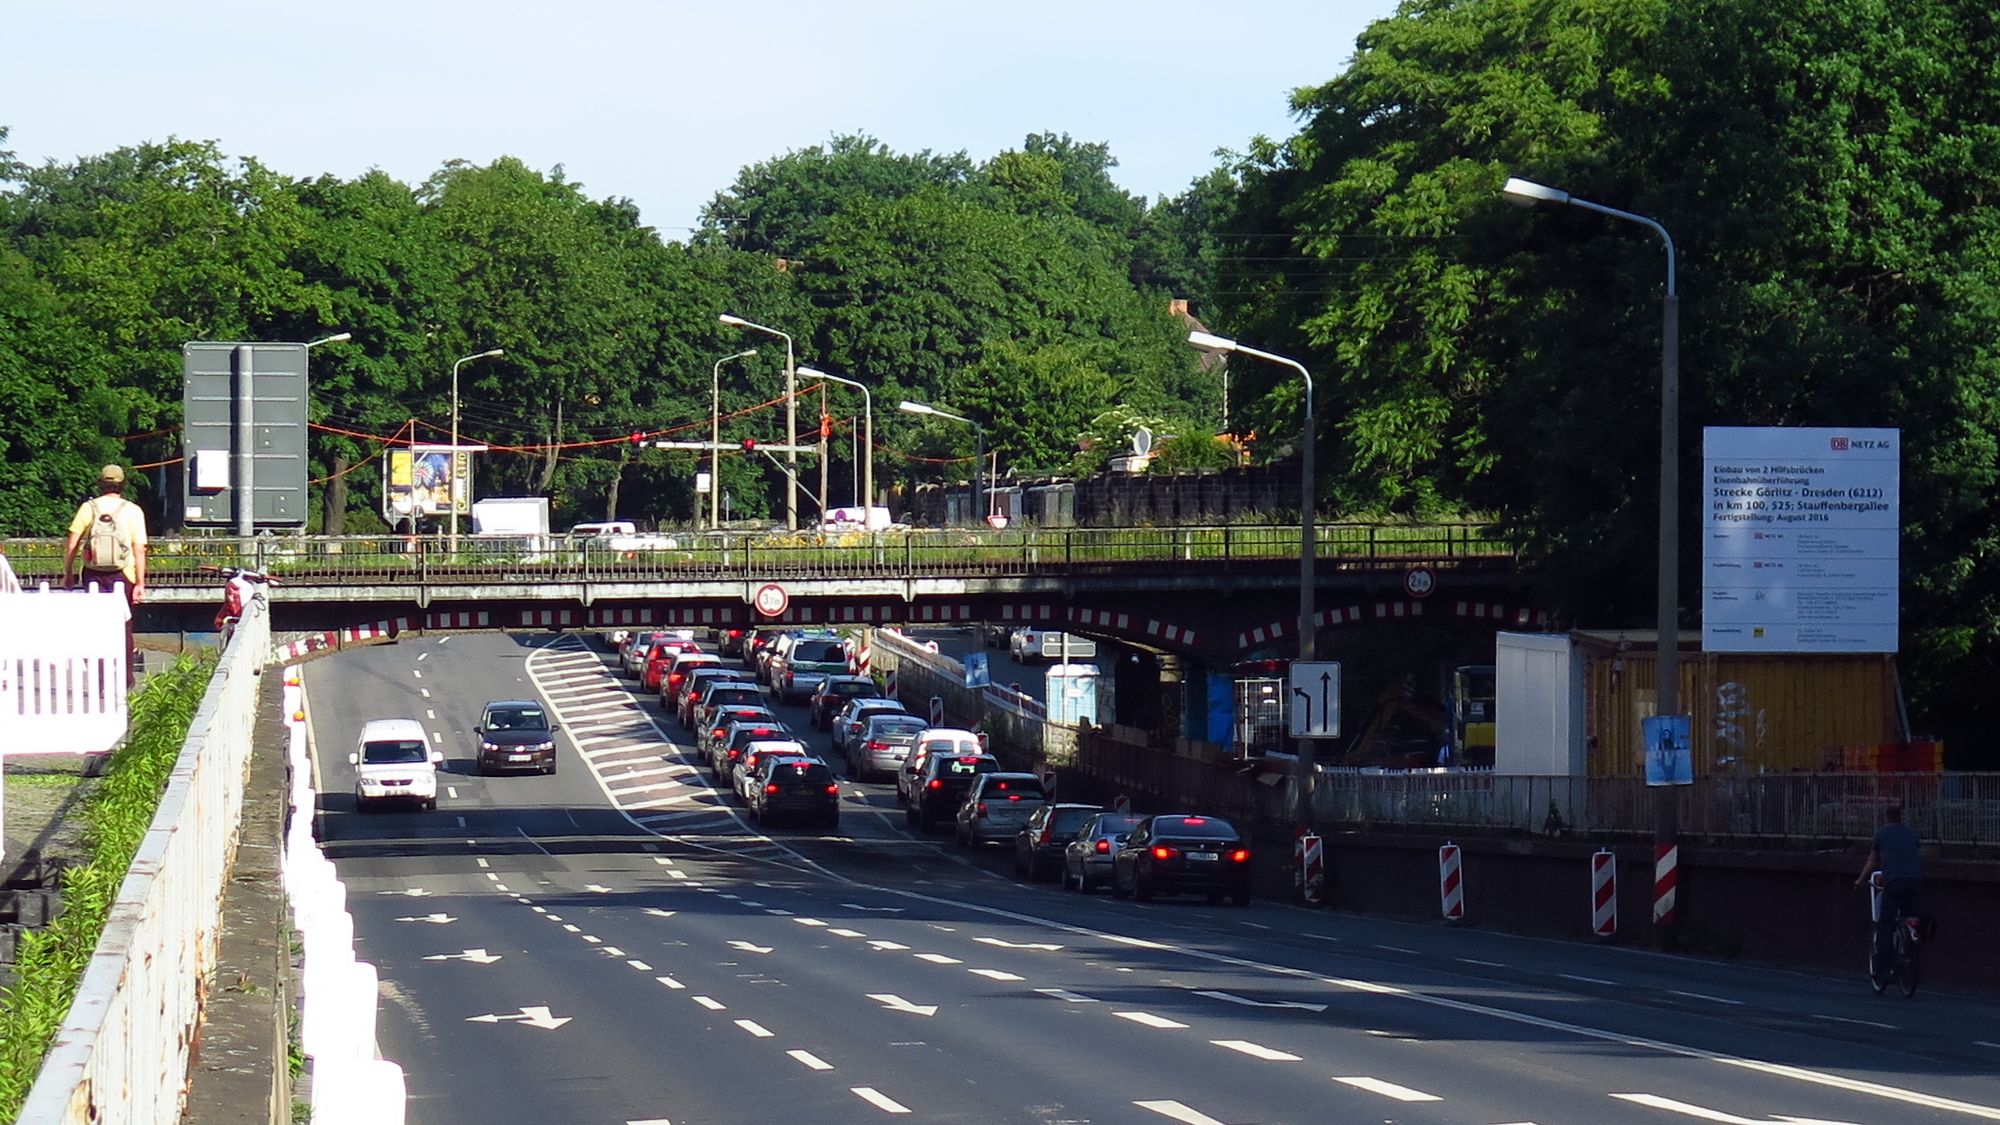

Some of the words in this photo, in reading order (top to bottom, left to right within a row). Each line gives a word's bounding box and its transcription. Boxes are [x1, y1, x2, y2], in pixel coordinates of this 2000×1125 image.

[1831, 438, 1848, 450] DB
[1851, 440, 1874, 449] NETZ
[1877, 441, 1890, 449] AG
[1713, 465, 1743, 473] Einbau
[1770, 465, 1824, 474] Hilfsbrücken
[1713, 476, 1810, 486] Eisenbahnüberführung
[1713, 487, 1753, 497] Strecke
[1756, 487, 1792, 497] Görlitz
[1802, 488, 1845, 497] Dresden
[1848, 488, 1883, 499] (6212)
[1713, 501, 1723, 509] in
[1727, 501, 1742, 509] km
[1746, 501, 1768, 511] 100,
[1797, 501, 1889, 512] Stauffenbergallee
[1713, 513, 1774, 522] Fertigstellung:
[1776, 514, 1806, 522] August
